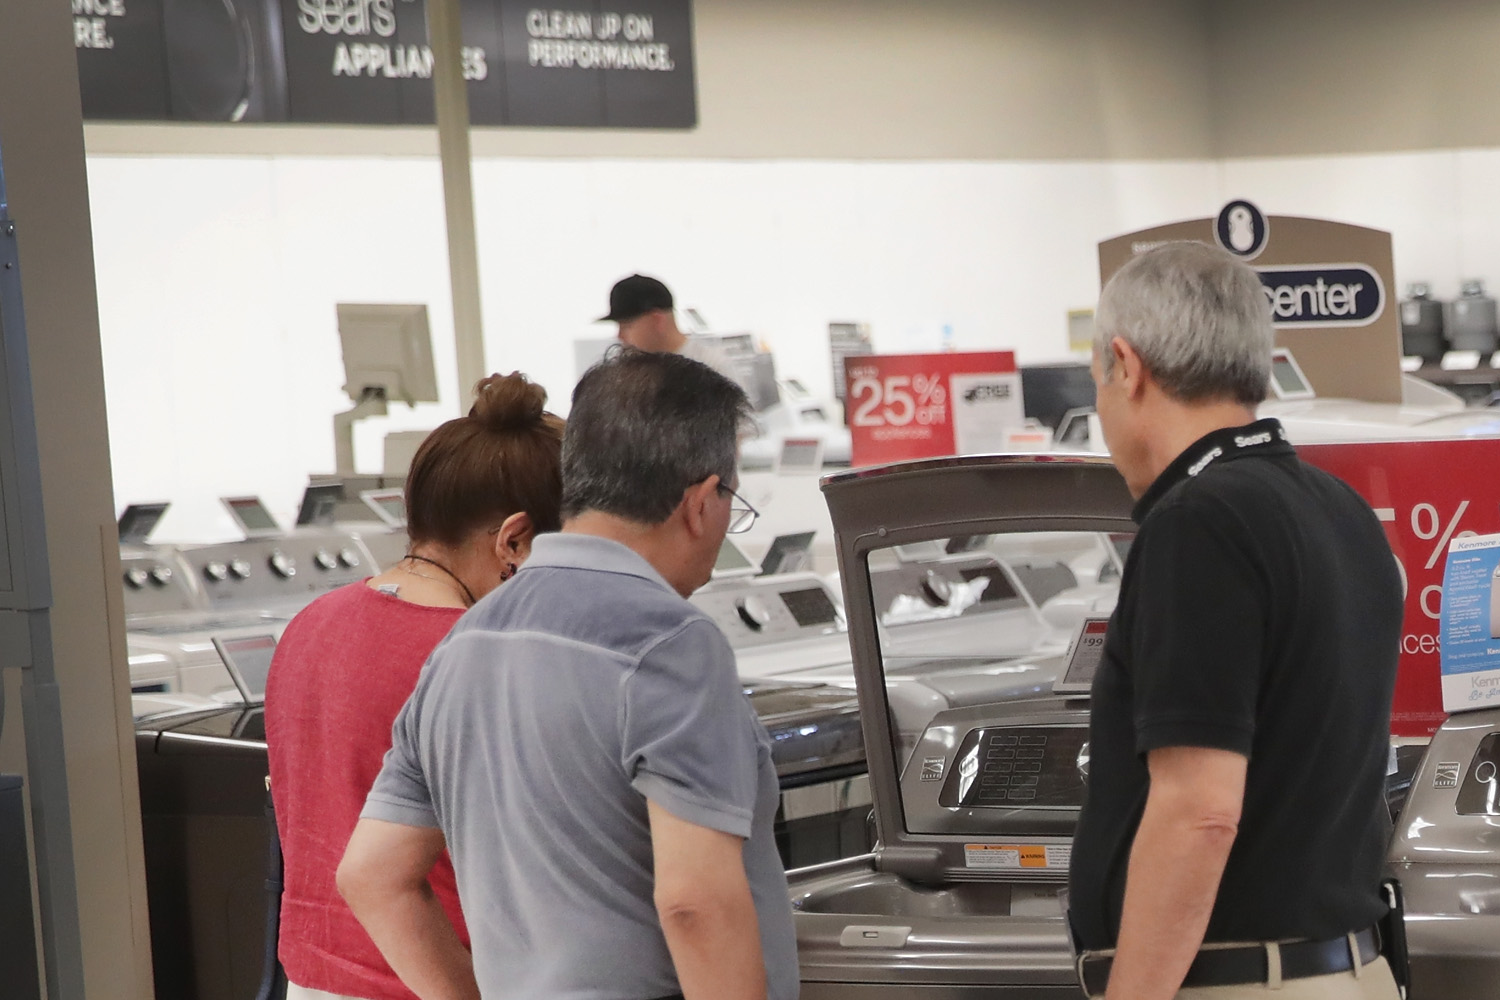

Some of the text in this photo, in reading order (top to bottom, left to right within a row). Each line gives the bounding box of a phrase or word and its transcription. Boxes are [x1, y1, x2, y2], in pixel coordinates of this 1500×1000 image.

[526, 9, 592, 38] CLEAN
[623, 14, 653, 41] ON
[332, 43, 488, 80] APPLIANES
[528, 42, 675, 71] PERFORMANCE.
[1234, 430, 1271, 448] Sears
[1188, 446, 1223, 477] Sears
[1457, 539, 1497, 550] Kenmore
